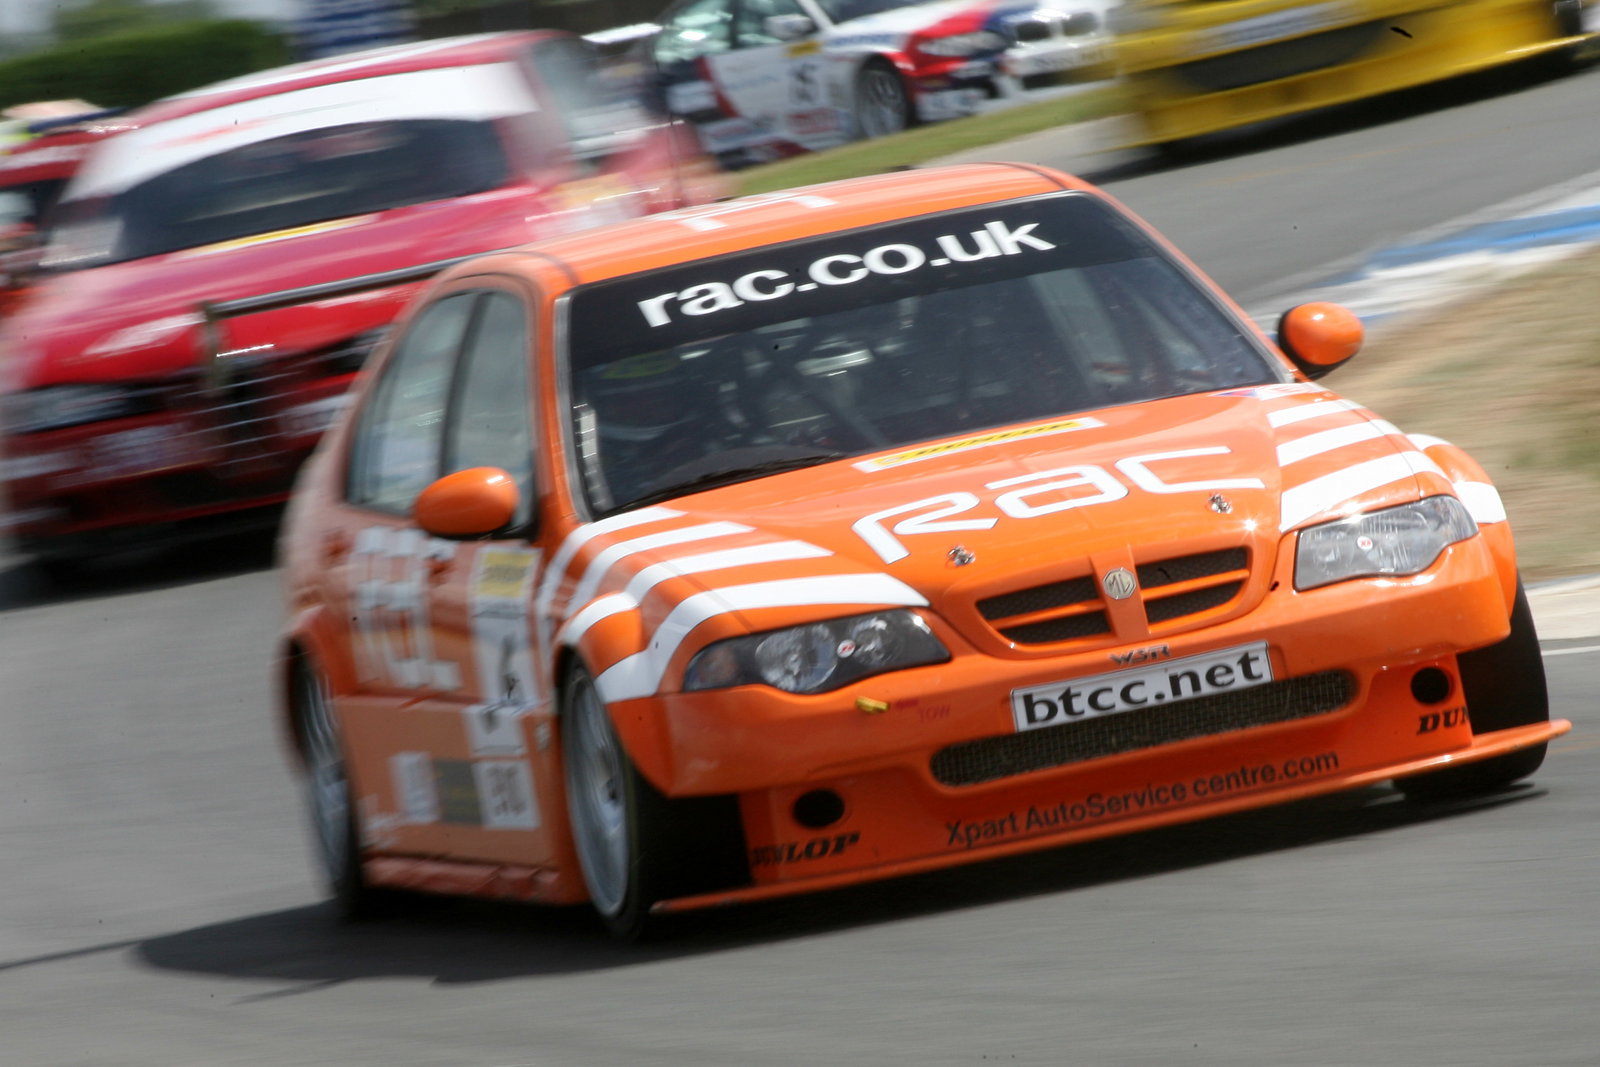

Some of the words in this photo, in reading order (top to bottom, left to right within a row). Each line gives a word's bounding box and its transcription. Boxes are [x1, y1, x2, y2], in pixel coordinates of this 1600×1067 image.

[636, 220, 1057, 328] rac.co.uk
[1021, 651, 1264, 725] btcc.net
[944, 811, 1017, 848] Xpart
[1024, 780, 1188, 831] AutoService
[1193, 750, 1340, 798] centre.com
